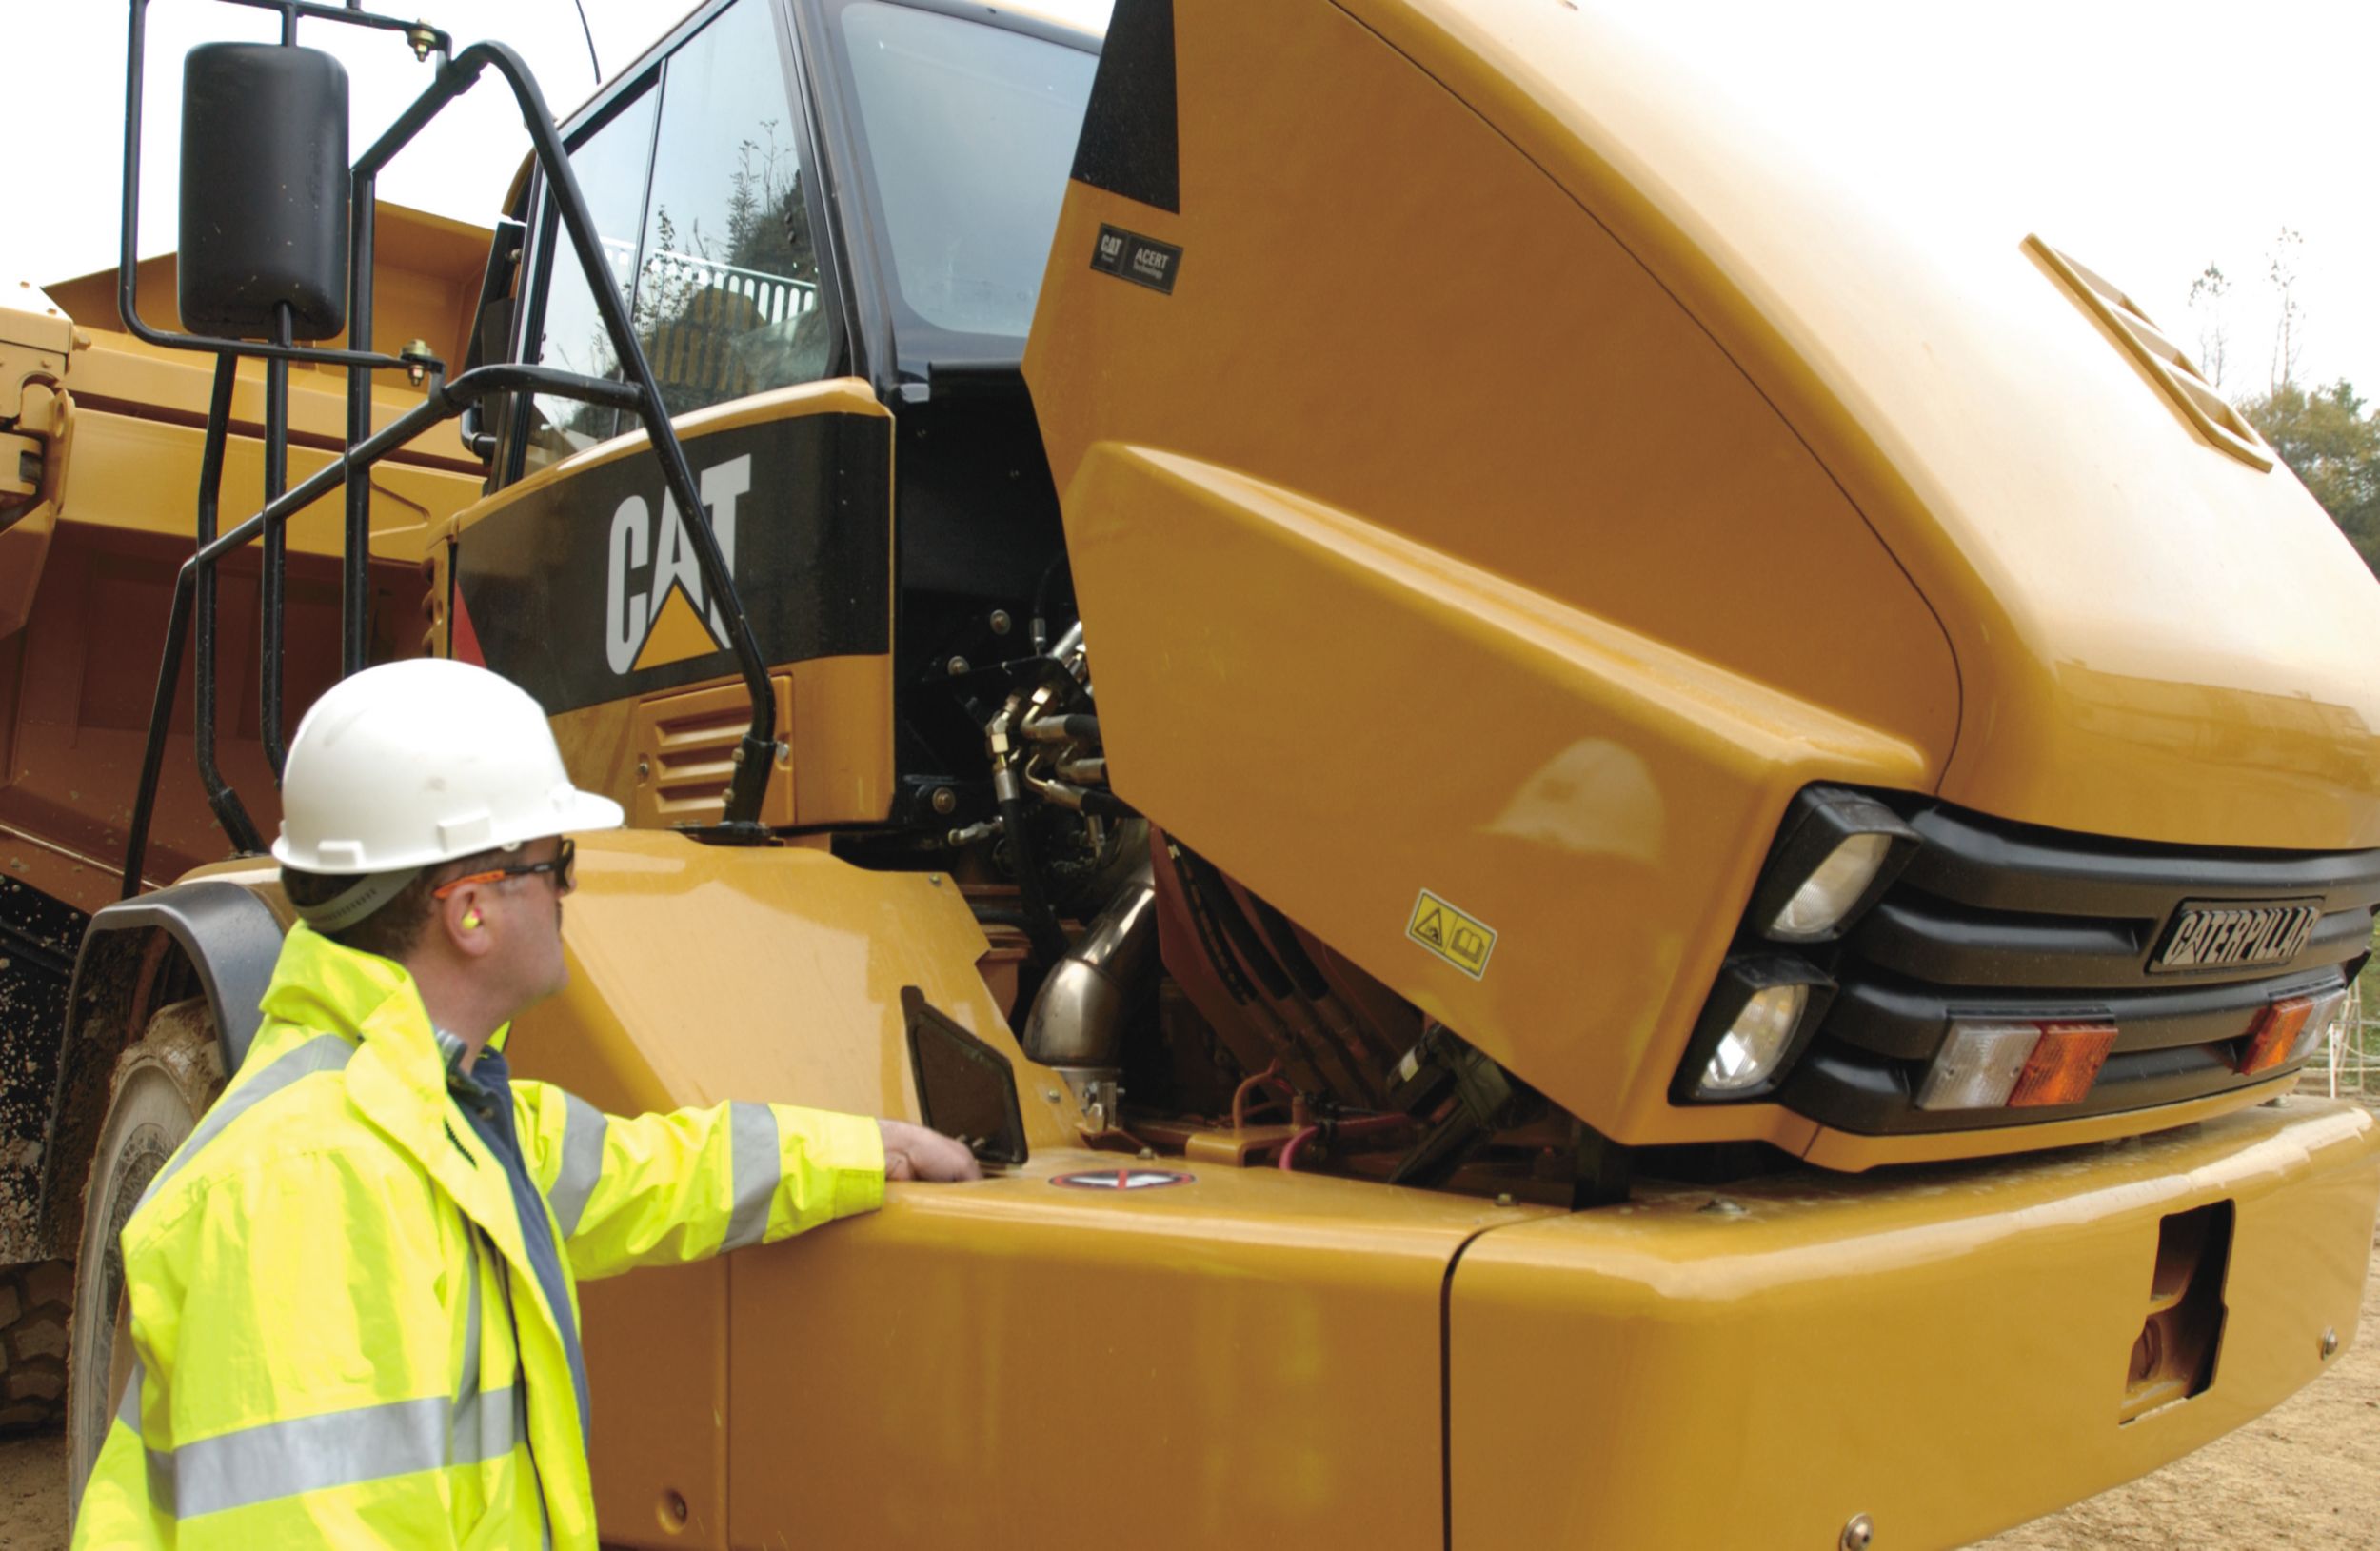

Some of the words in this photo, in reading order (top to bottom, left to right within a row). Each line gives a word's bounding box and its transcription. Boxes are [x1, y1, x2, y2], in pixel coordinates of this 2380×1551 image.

[1101, 234, 1122, 256] CAT
[1135, 248, 1169, 269] ACERT
[606, 453, 751, 675] CAT
[2162, 907, 2320, 965] CATERPILLAR
